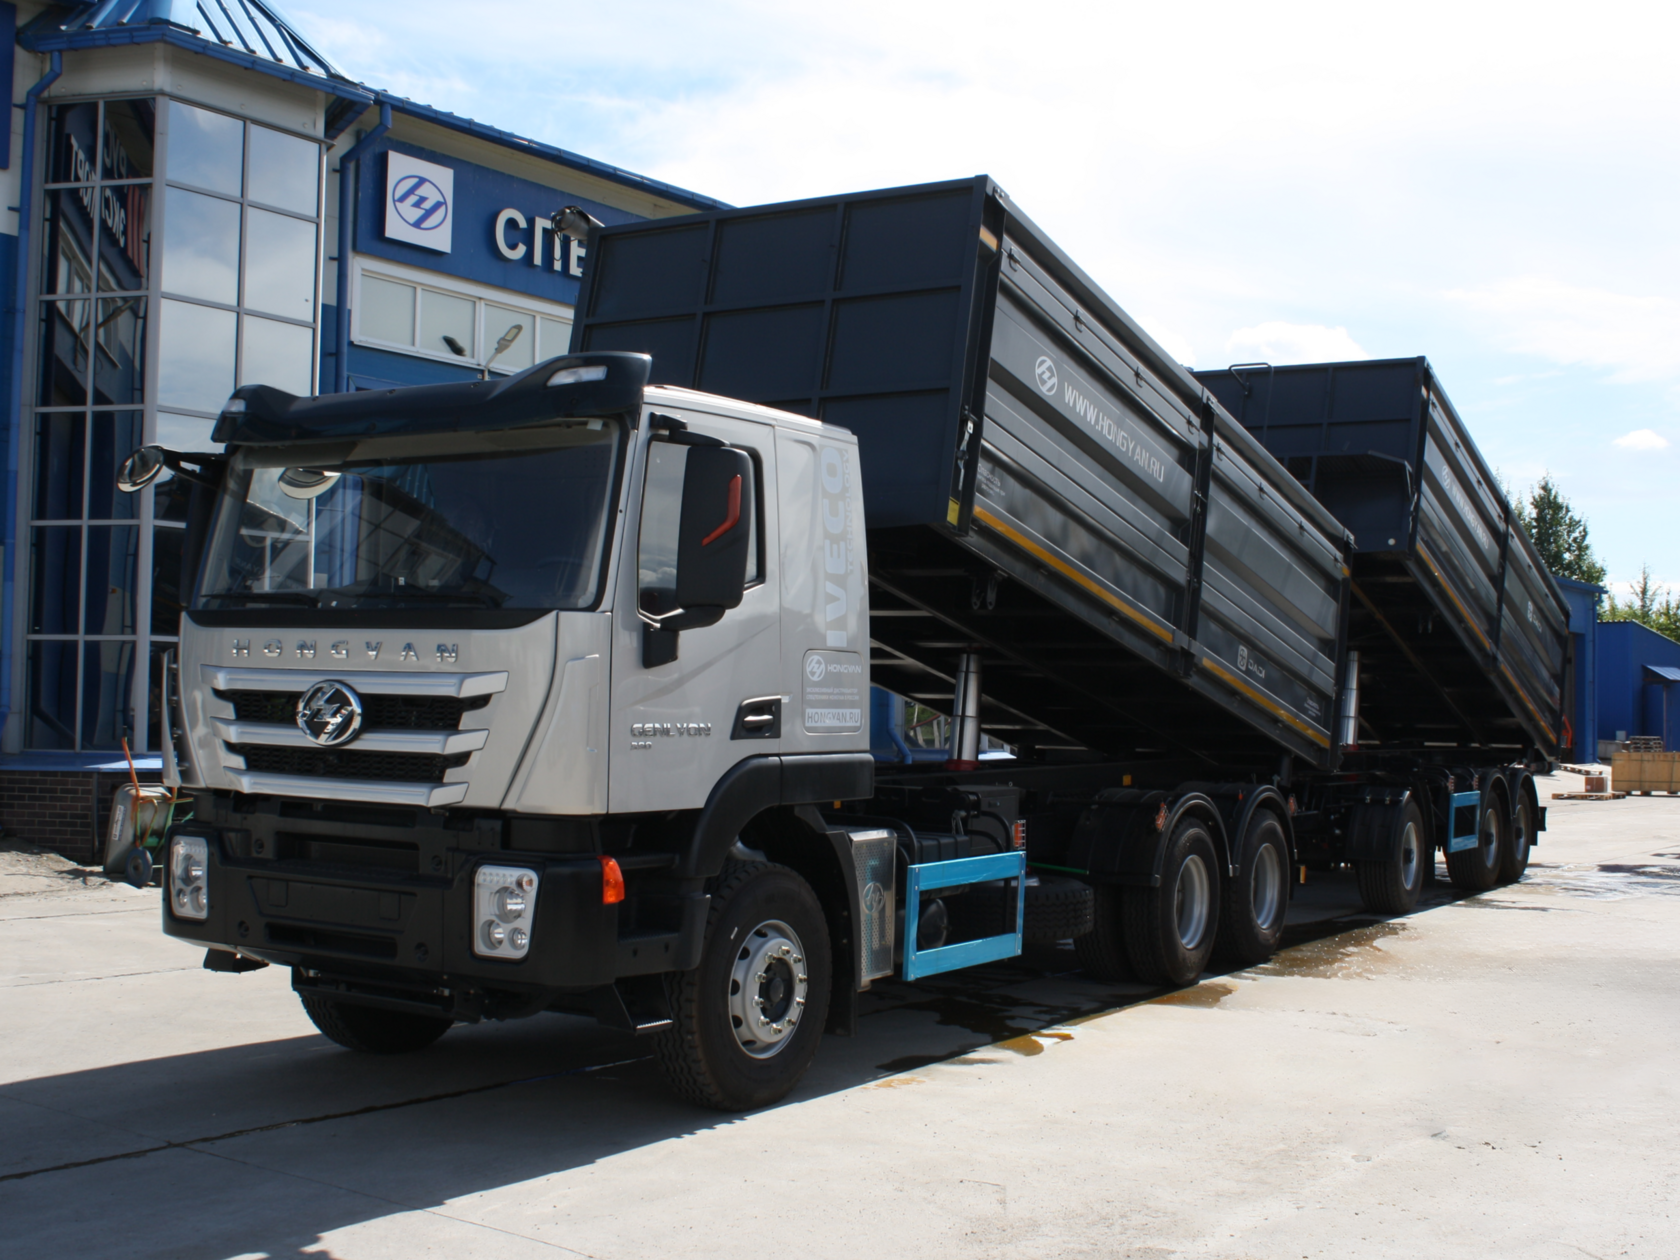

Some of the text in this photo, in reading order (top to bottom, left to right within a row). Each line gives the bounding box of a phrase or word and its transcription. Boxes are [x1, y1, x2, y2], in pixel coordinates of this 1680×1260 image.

[1064, 381, 1165, 483] WWW.HONGYAN.RU
[820, 446, 848, 648] IVECO
[807, 711, 860, 724] HONGYAN.RU
